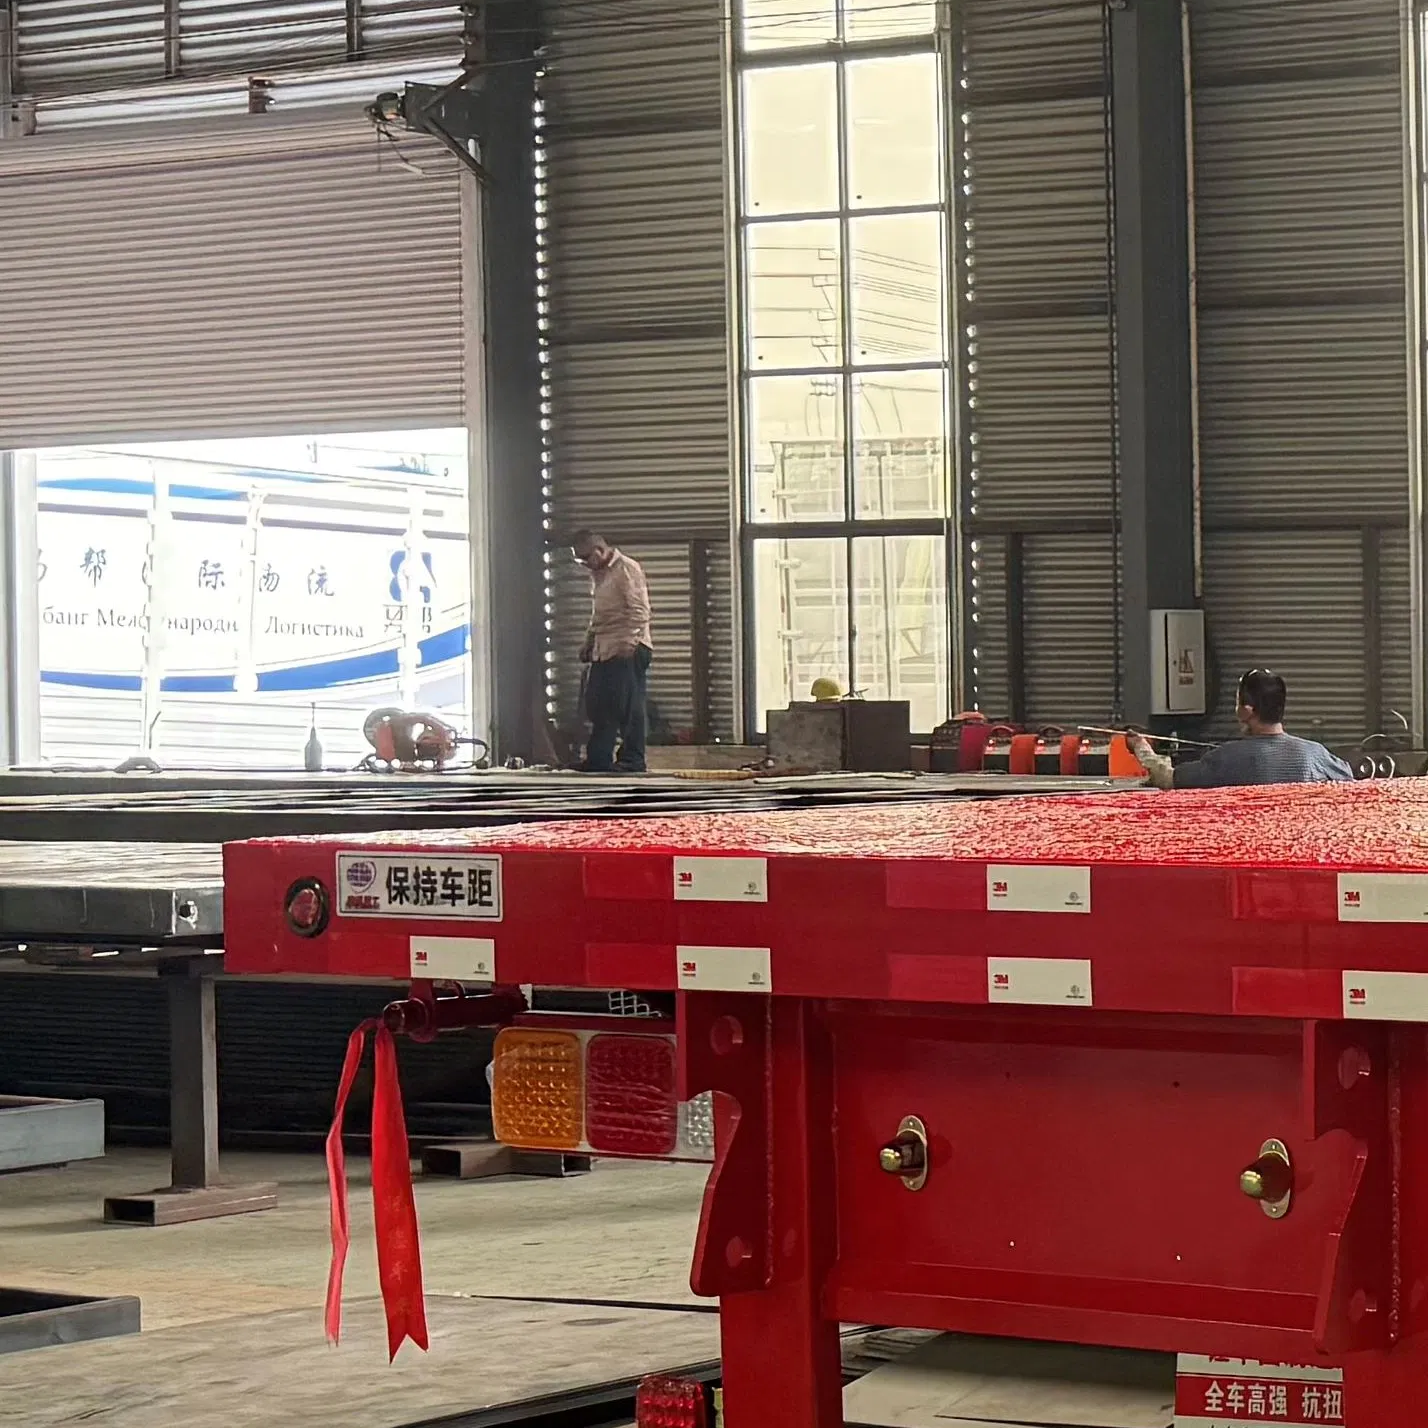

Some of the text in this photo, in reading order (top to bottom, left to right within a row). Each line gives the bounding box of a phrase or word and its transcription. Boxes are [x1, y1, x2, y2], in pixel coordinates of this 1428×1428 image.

[264, 615, 365, 638] Логистика
[385, 865, 494, 907] 保持车距
[1344, 891, 1360, 902] 3M
[1349, 988, 1366, 999] 3M
[1204, 1379, 1288, 1417] 全车高强
